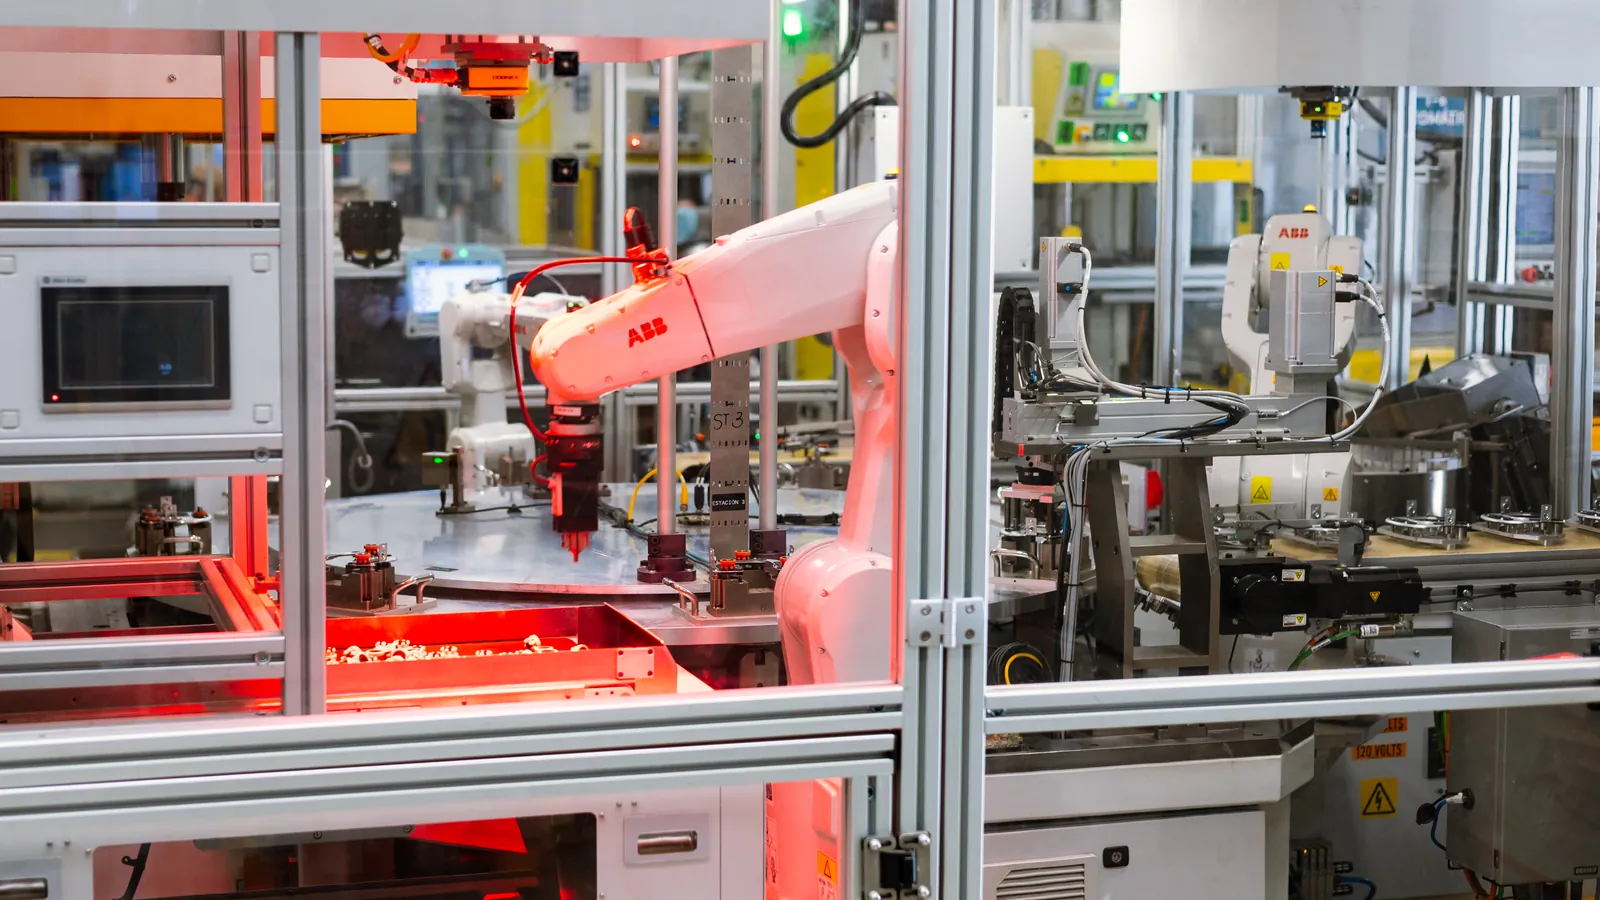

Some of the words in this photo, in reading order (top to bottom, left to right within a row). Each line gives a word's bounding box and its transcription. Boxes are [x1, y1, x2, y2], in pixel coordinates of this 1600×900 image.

[1279, 227, 1308, 239] ABB
[629, 317, 667, 348] ABB
[713, 413, 729, 430] ST
[731, 411, 743, 428] 3
[1384, 717, 1404, 731] LTS
[1356, 745, 1372, 759] 120
[1374, 743, 1402, 758] VOLTS
